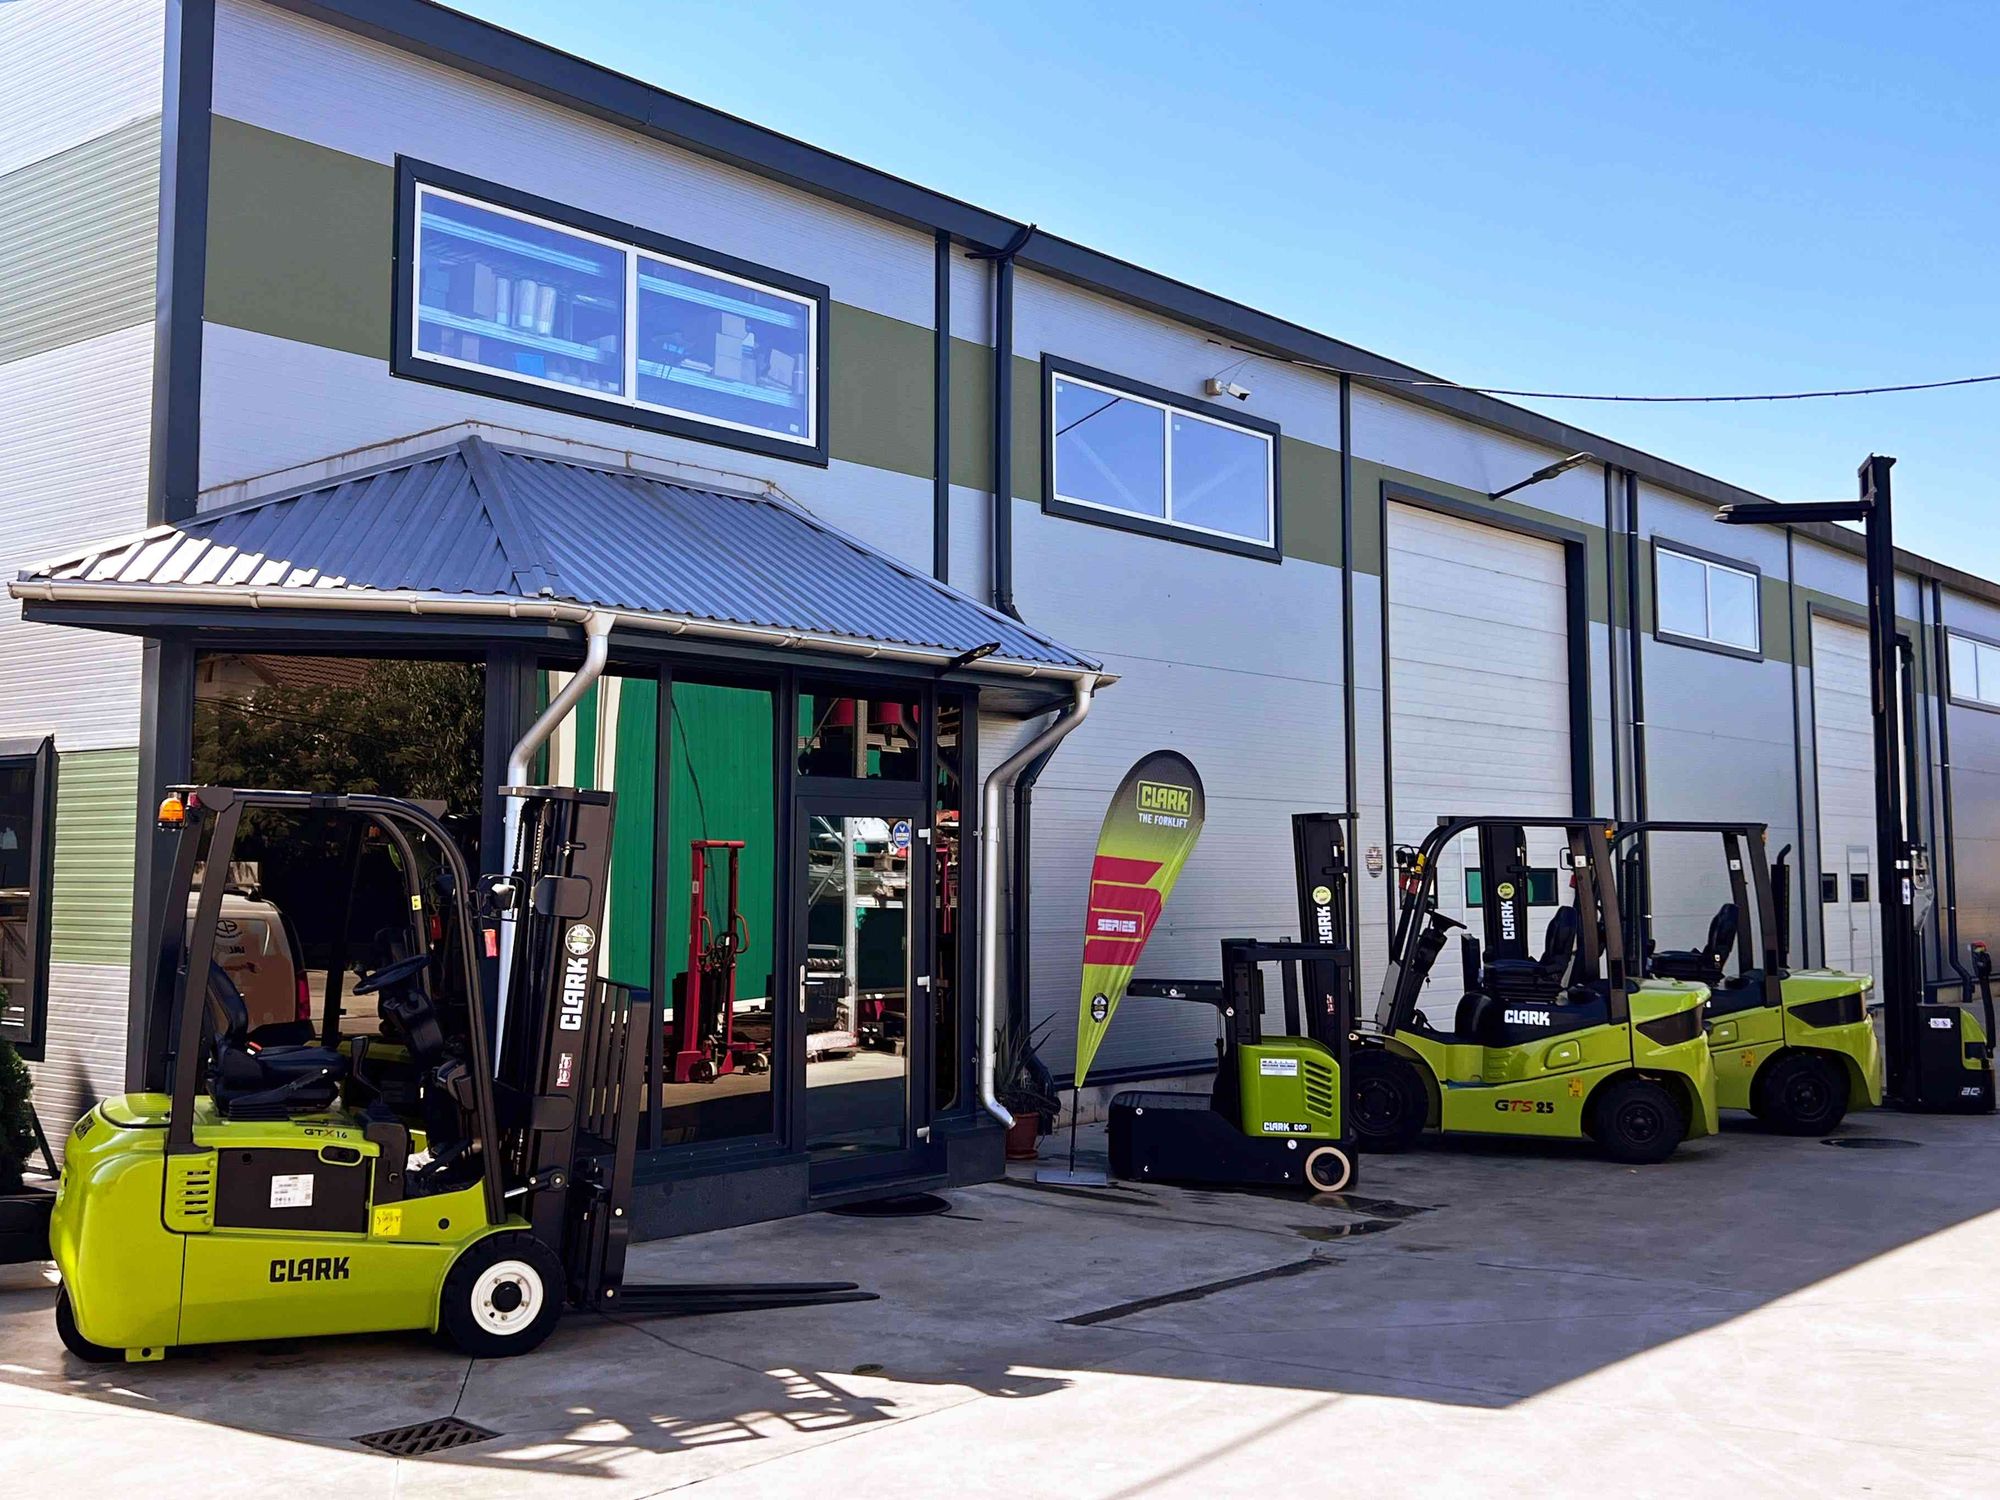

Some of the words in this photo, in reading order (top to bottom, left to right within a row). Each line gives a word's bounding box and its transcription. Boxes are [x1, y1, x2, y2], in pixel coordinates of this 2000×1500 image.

[1141, 786, 1189, 813] CLARK
[1138, 813, 1153, 824] THE
[1154, 816, 1188, 828] FORKLIFT
[1097, 918, 1137, 933] SERIES
[1317, 906, 1333, 944] LARK
[1501, 901, 1515, 940] CLARK
[560, 957, 589, 1031] CLARK
[1504, 1010, 1550, 1026] CLARK
[1495, 1099, 1534, 1112] GTS
[1536, 1102, 1554, 1113] 25
[304, 1128, 335, 1137] GTX
[1263, 1122, 1290, 1132] CLARK
[270, 1257, 349, 1283] CLARK
